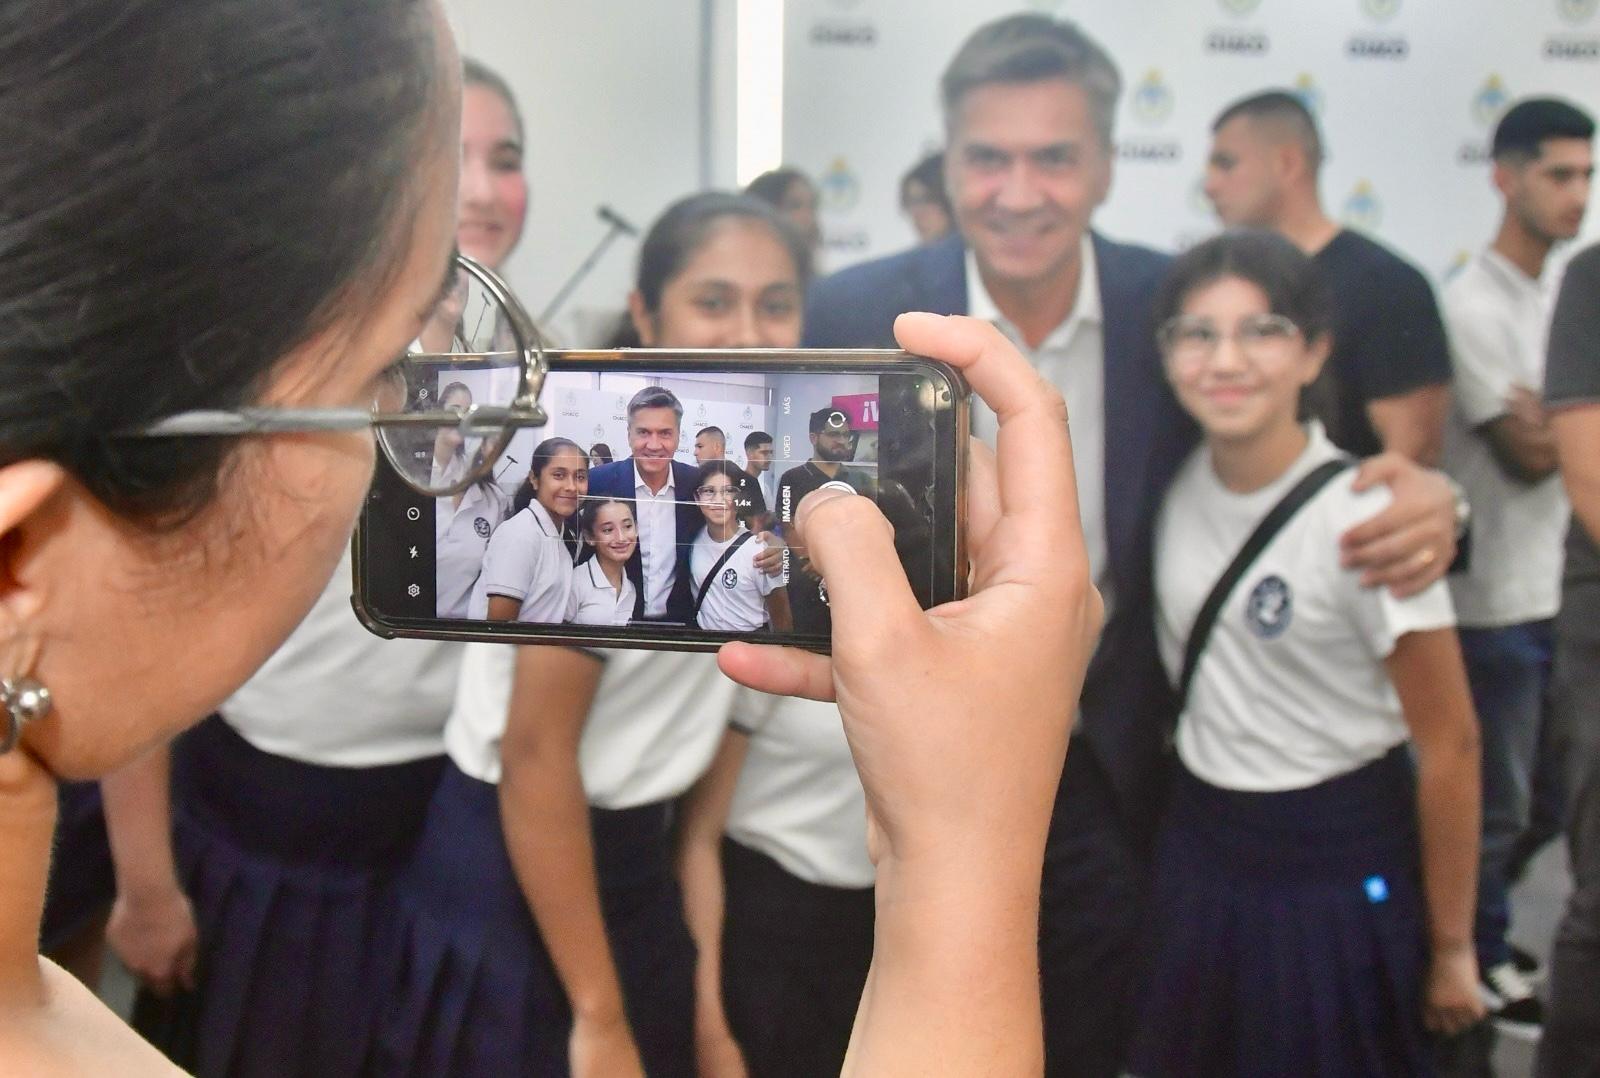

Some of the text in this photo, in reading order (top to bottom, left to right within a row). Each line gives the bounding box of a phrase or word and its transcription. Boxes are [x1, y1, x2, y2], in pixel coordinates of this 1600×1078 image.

[783, 396, 791, 415] MÁS
[783, 435, 791, 459] VIDEO
[740, 478, 746, 487] 2
[782, 485, 791, 523] IMAGEN
[783, 548, 791, 584] RETRATO
